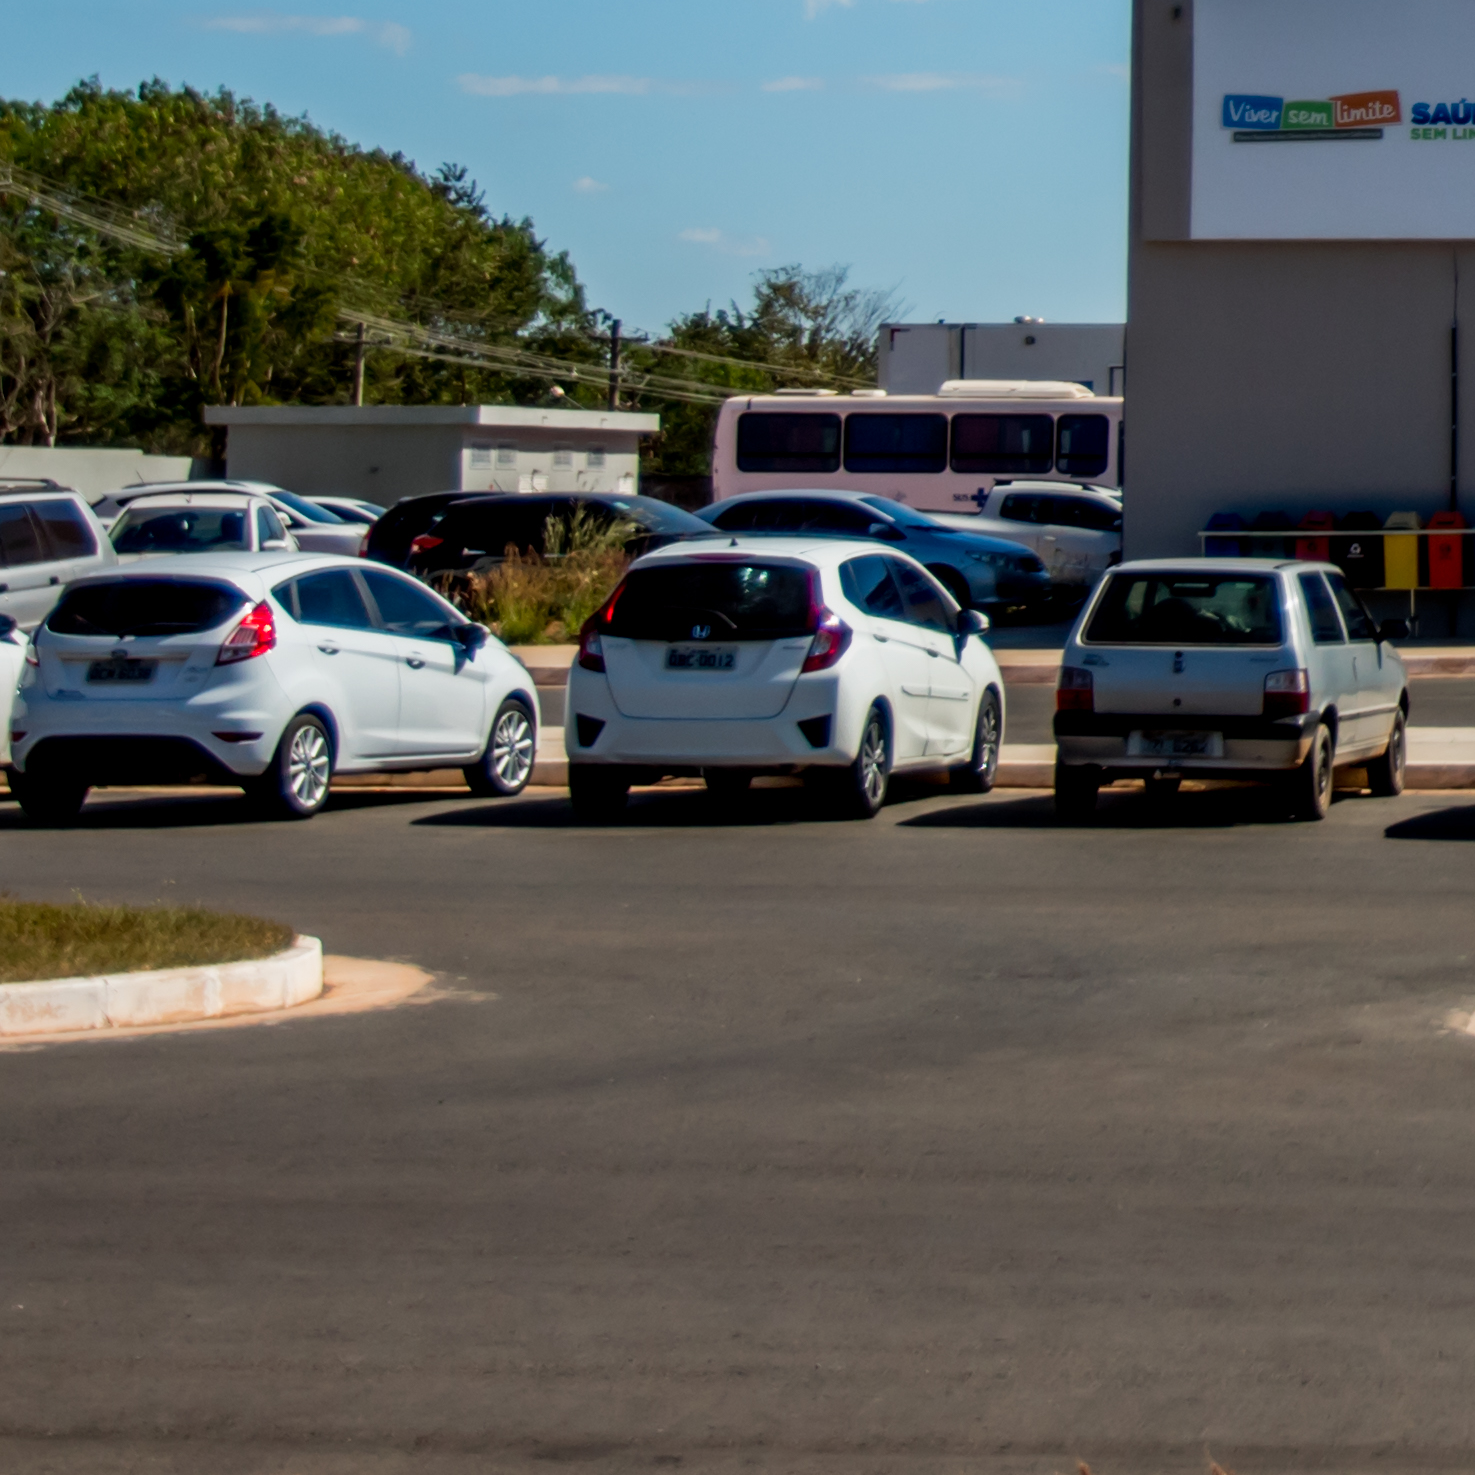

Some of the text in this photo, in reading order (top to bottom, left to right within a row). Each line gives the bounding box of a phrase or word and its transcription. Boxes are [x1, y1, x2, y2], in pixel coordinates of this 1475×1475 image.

[1228, 99, 1396, 125] Viver sem limite
[1410, 127, 1449, 141] SEM
